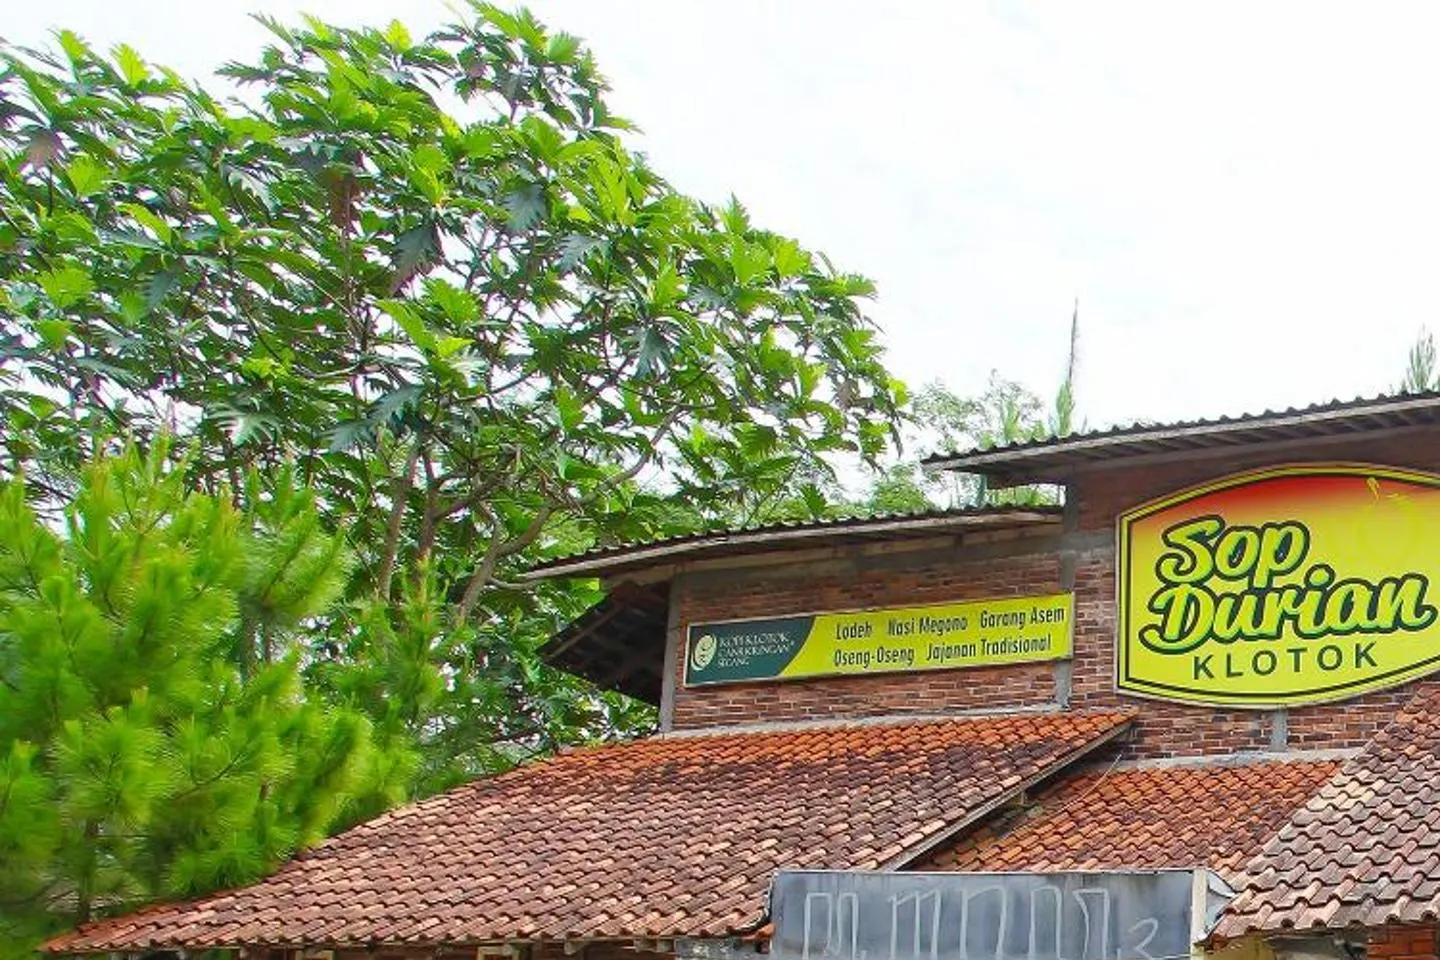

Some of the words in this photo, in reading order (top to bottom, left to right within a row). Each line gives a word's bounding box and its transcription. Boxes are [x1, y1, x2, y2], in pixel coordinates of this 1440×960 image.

[1155, 514, 1310, 590] Sop
[836, 620, 873, 640] Lodeh
[888, 617, 915, 636] Nasi
[980, 610, 1026, 630] Garang
[1030, 607, 1065, 624] Asem
[1138, 564, 1438, 655] Durian
[834, 646, 916, 669] Oseng-Oseng
[925, 641, 977, 662] Jajanan
[980, 634, 1052, 656] Tradisional
[1193, 641, 1378, 681] KLOTOK
